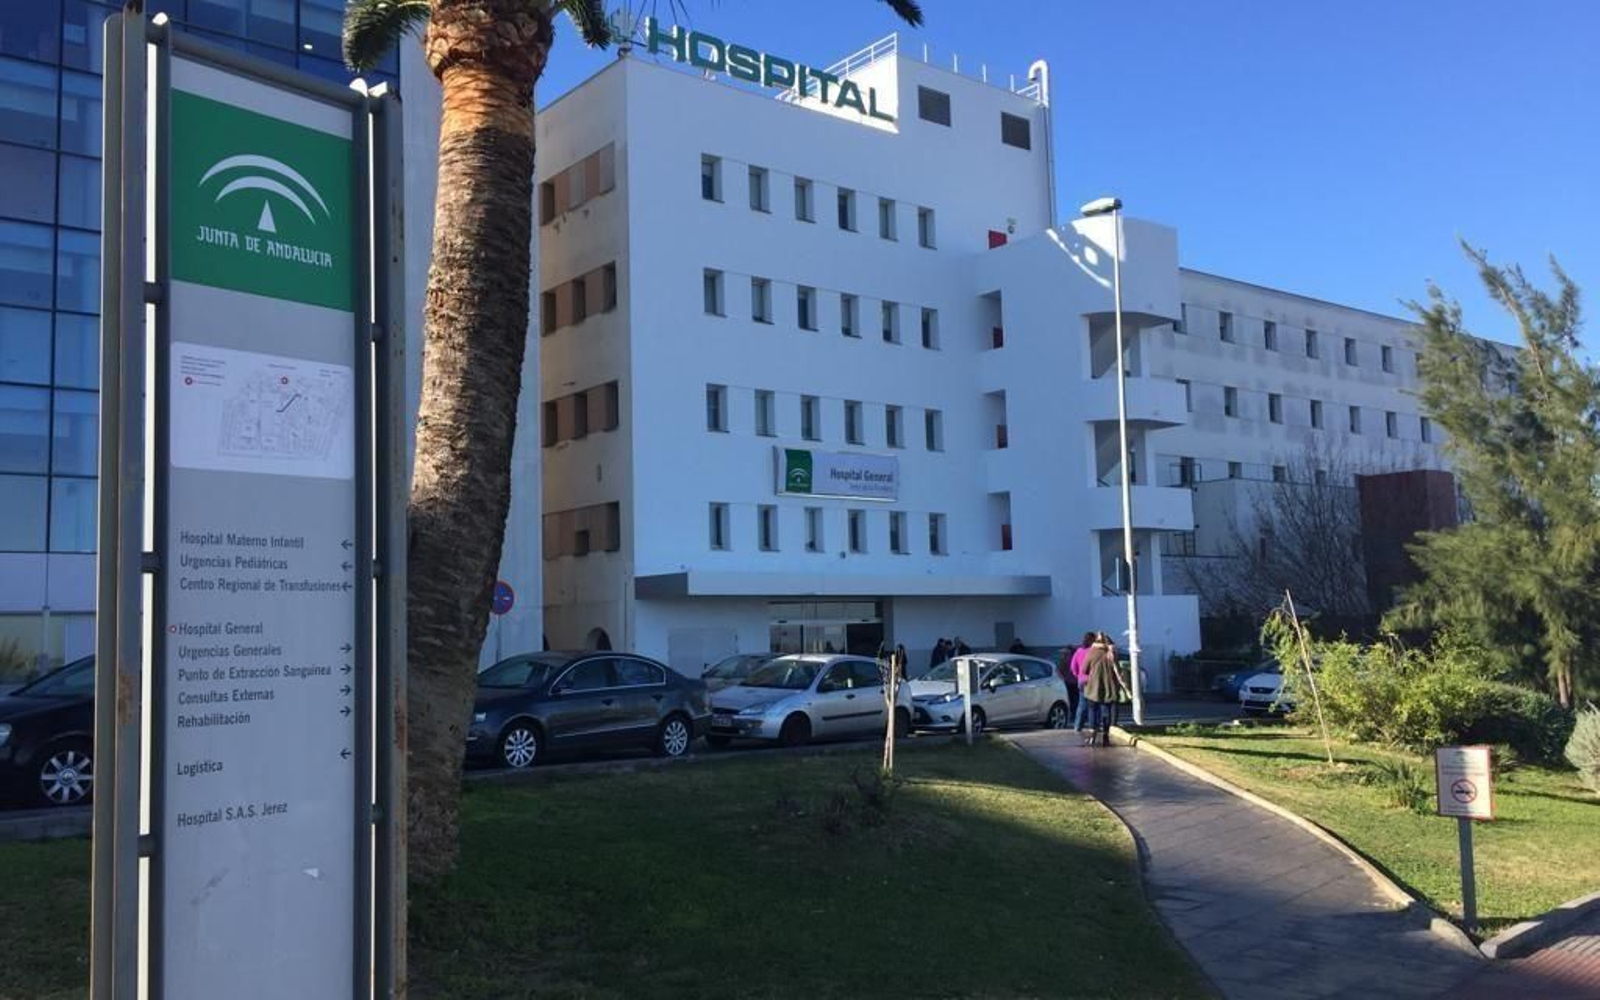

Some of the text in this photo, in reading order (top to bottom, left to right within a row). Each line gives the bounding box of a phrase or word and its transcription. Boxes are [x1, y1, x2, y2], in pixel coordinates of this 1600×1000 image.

[645, 16, 895, 123] HOSPITAL
[197, 225, 239, 248] JUNTA
[245, 235, 261, 253] DE
[830, 468, 894, 482] Hospital General
[180, 531, 305, 549] Hospital Materno Infantil
[180, 554, 231, 570] Urgencias
[180, 577, 341, 593] Centro Regional de Transfusiones
[178, 621, 263, 637] Hospital General
[178, 643, 282, 661] Urgencias Generales
[178, 668, 209, 682] Punto
[212, 667, 225, 680] de
[178, 687, 275, 705] Consultas Externas
[177, 712, 251, 728] Rehabilitación
[177, 802, 288, 828] Hospital S.A.S. Jerez
